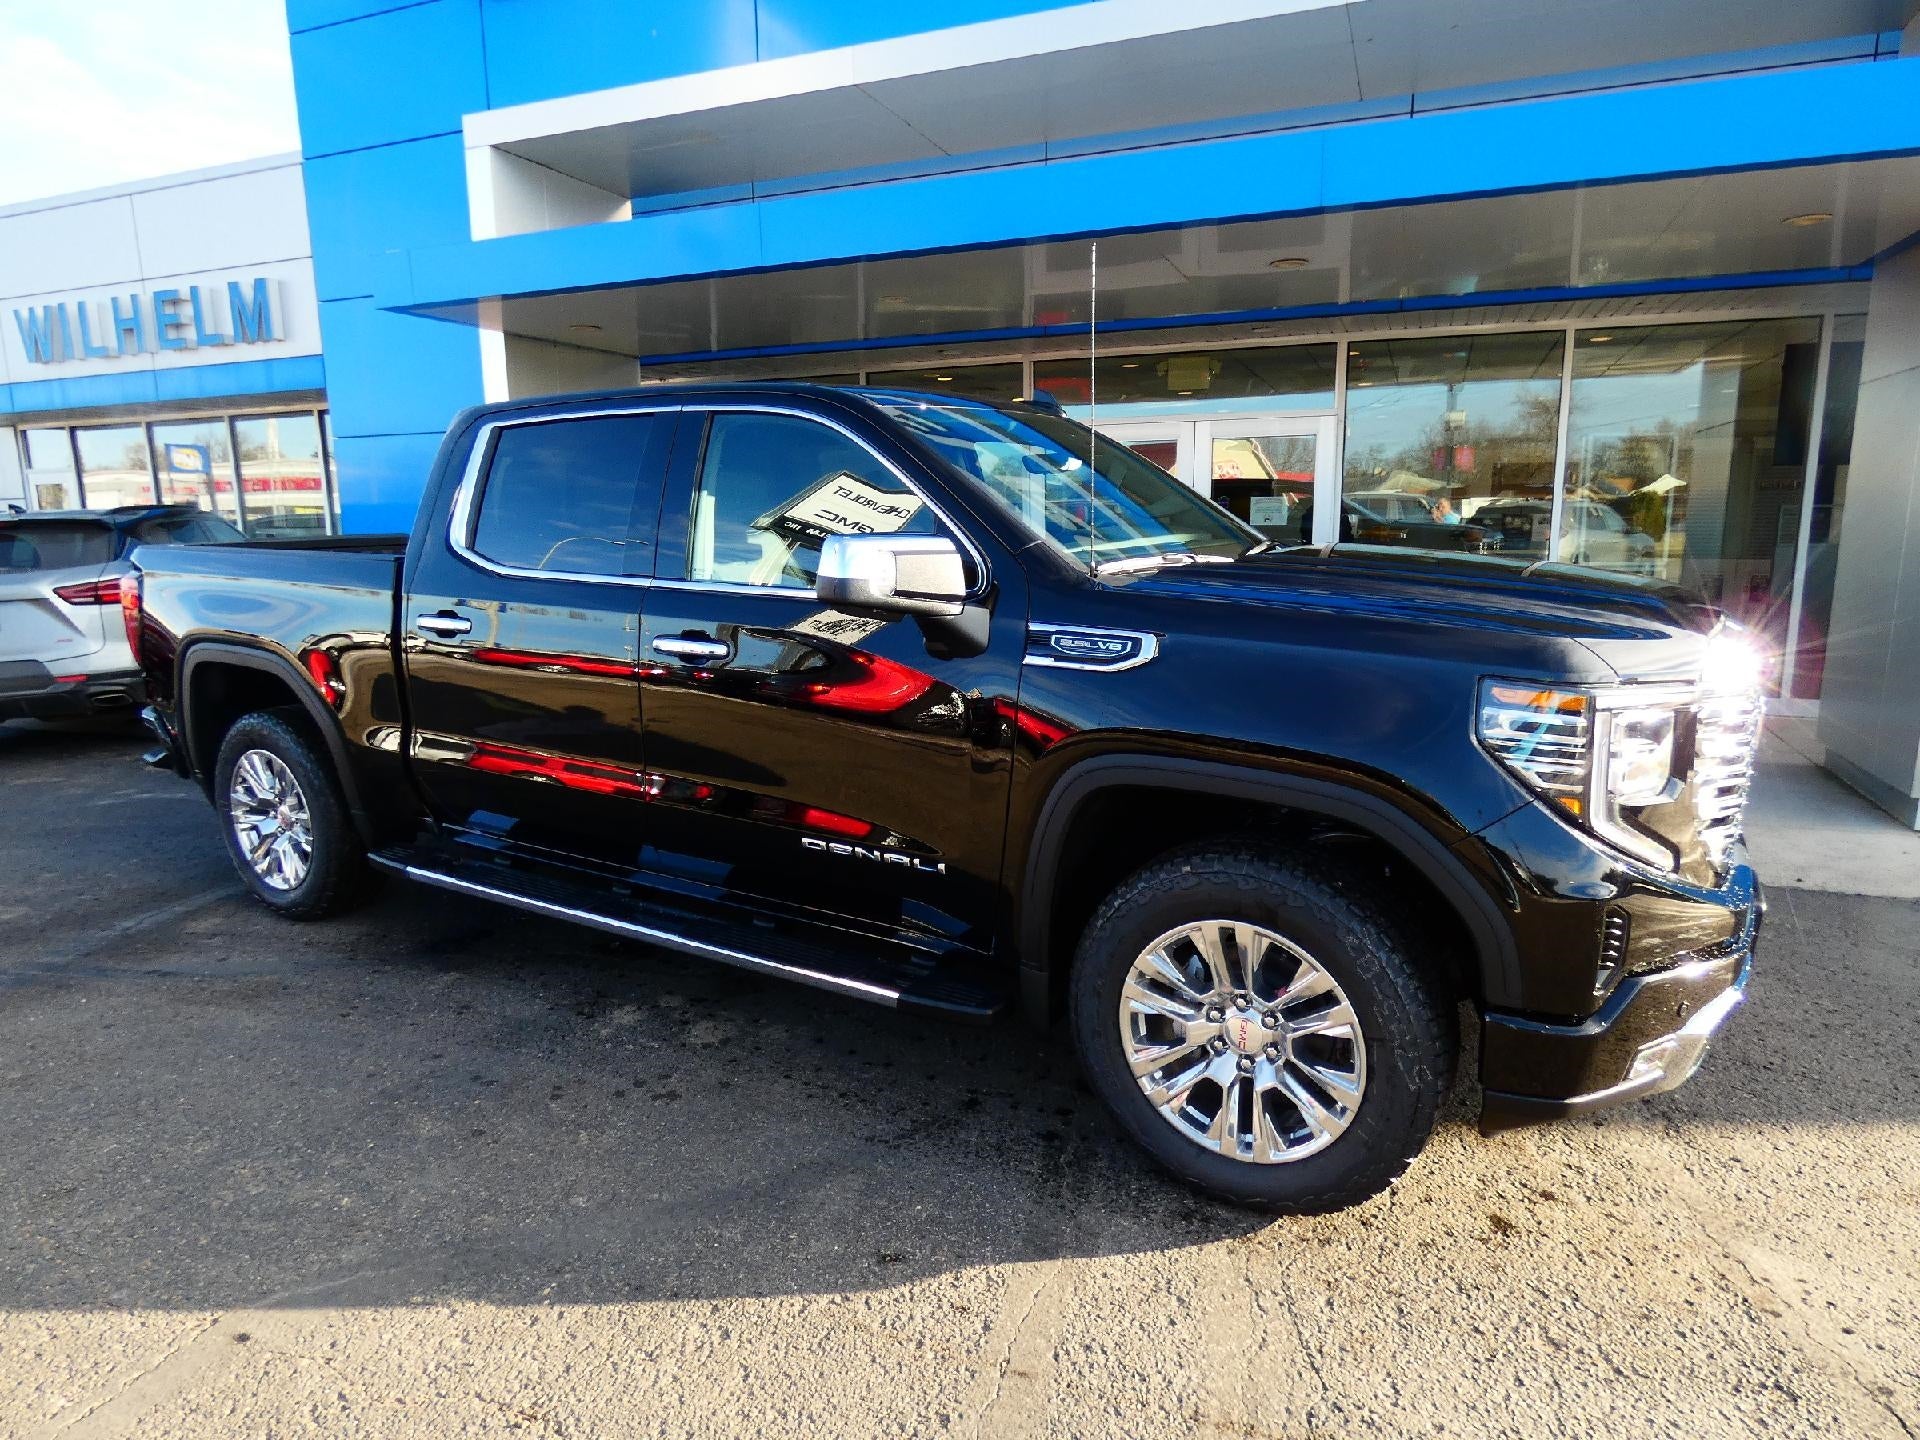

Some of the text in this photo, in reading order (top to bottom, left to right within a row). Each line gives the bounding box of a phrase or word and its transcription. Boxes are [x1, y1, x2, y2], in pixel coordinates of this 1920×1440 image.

[13, 278, 284, 364] WILHELM
[801, 837, 946, 875] DENALI
[1238, 1019, 1248, 1050] GMC
